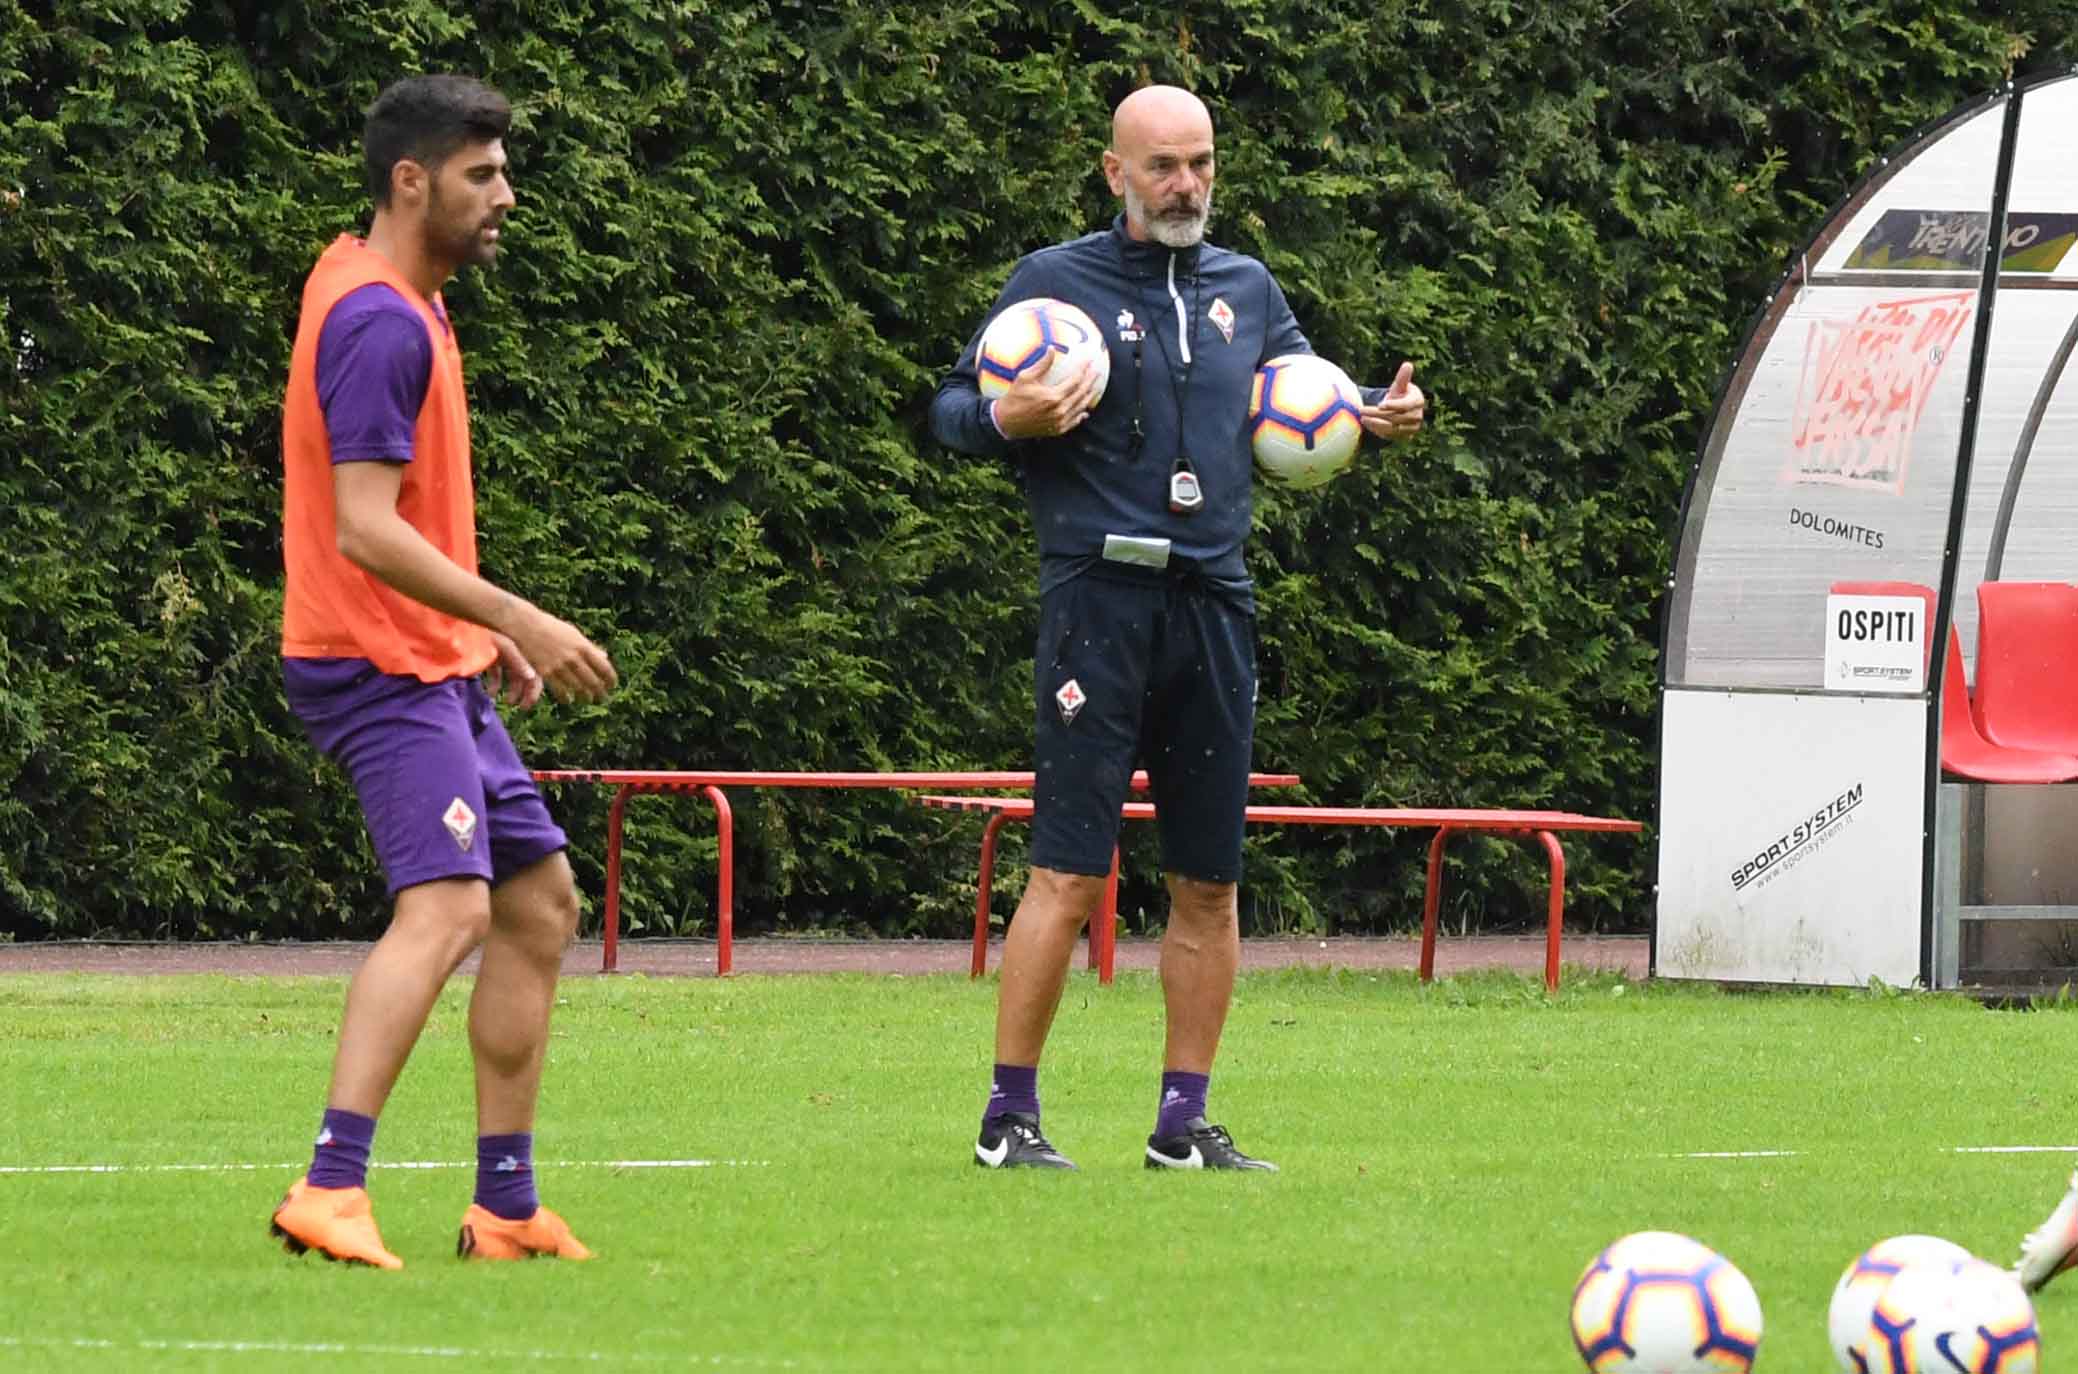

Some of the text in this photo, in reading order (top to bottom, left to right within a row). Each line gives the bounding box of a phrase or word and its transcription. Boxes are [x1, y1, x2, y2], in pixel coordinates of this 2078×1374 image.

[1909, 224, 2040, 255] TRENTNO
[1790, 508, 1884, 549] DOLOMITES
[1838, 609, 1914, 642] OSPITI
[1731, 783, 1862, 887] SPORT SYSTEM
